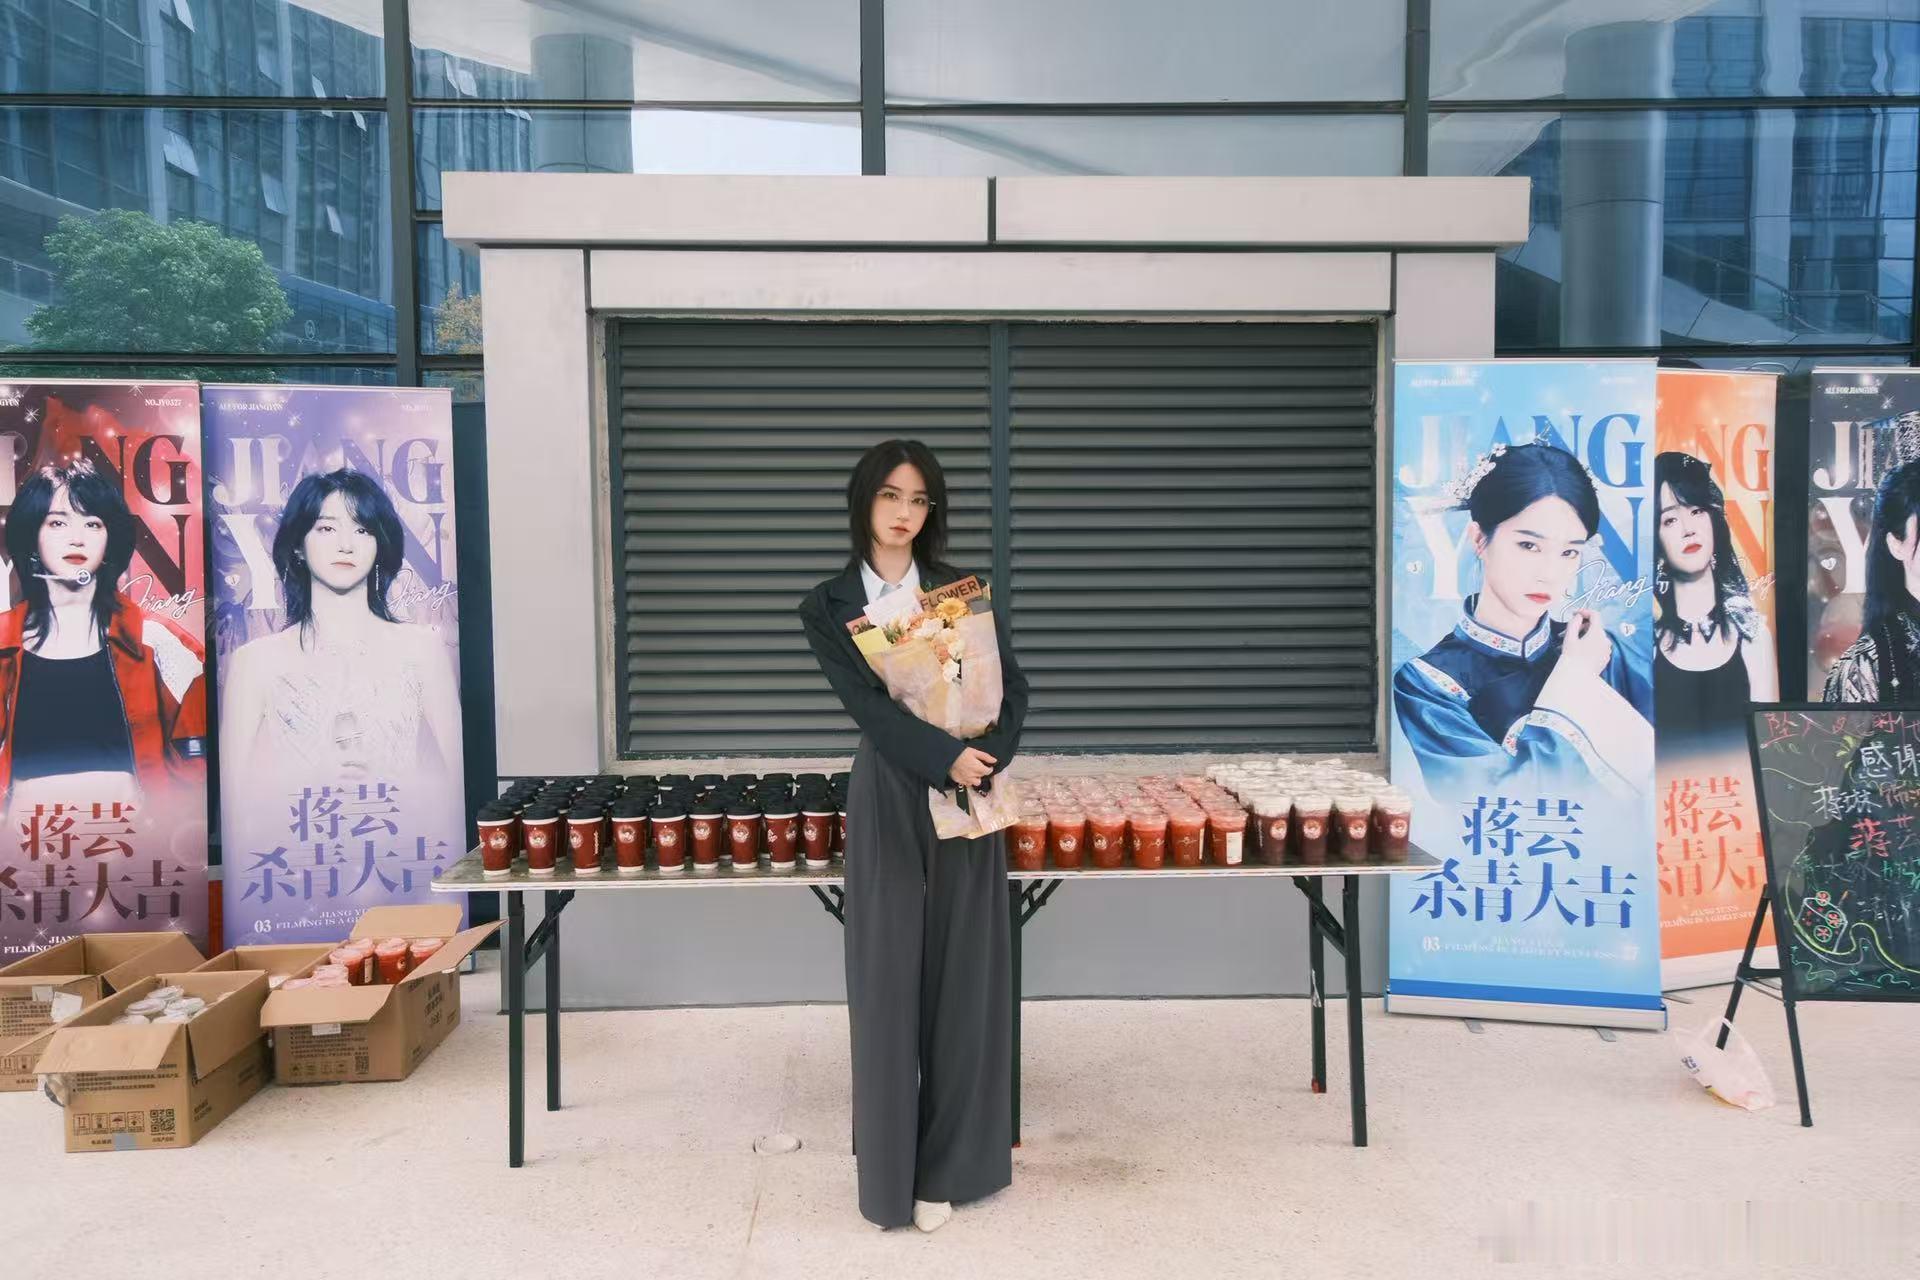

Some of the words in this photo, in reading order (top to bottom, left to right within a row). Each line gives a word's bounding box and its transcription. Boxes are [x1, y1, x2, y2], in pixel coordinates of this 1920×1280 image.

[218, 512, 446, 610] YN
[1405, 496, 1648, 601] YN
[19, 801, 136, 862] 蒋芸
[288, 781, 400, 842] 蒋芸
[1461, 794, 1585, 861] 蒋芸
[1408, 857, 1638, 929] 杀青大吉
